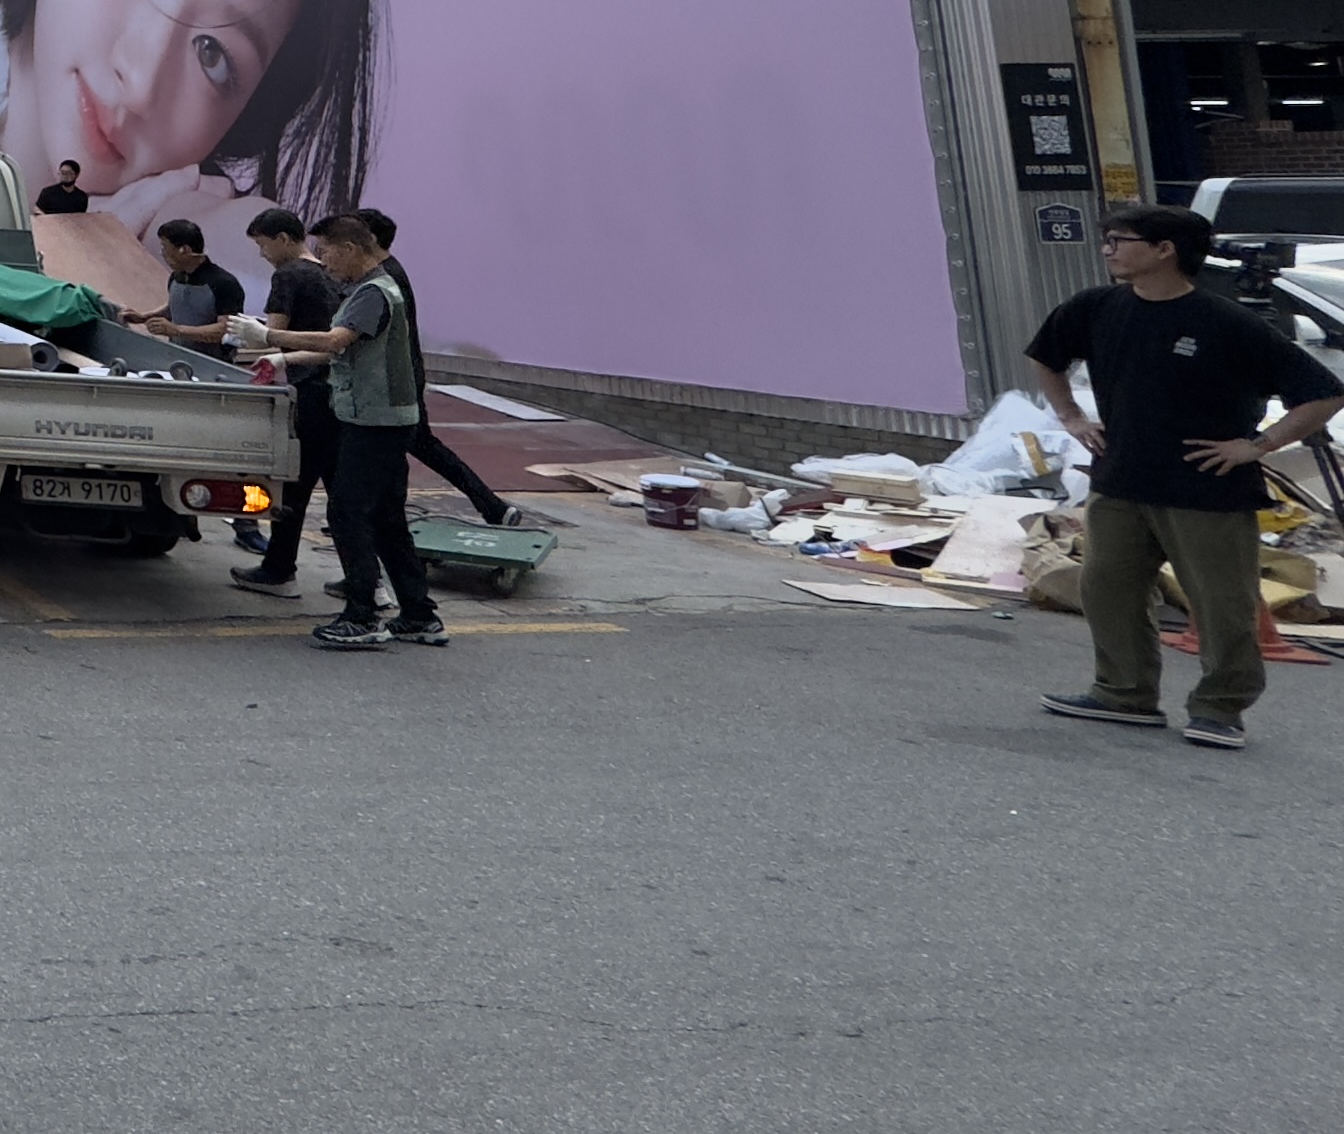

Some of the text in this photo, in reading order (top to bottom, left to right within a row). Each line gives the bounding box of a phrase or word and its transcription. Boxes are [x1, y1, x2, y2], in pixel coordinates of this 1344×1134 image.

[1051, 223, 1072, 239] 95
[35, 420, 154, 441] HYUNDAI
[32, 478, 132, 503] 82거 9170
